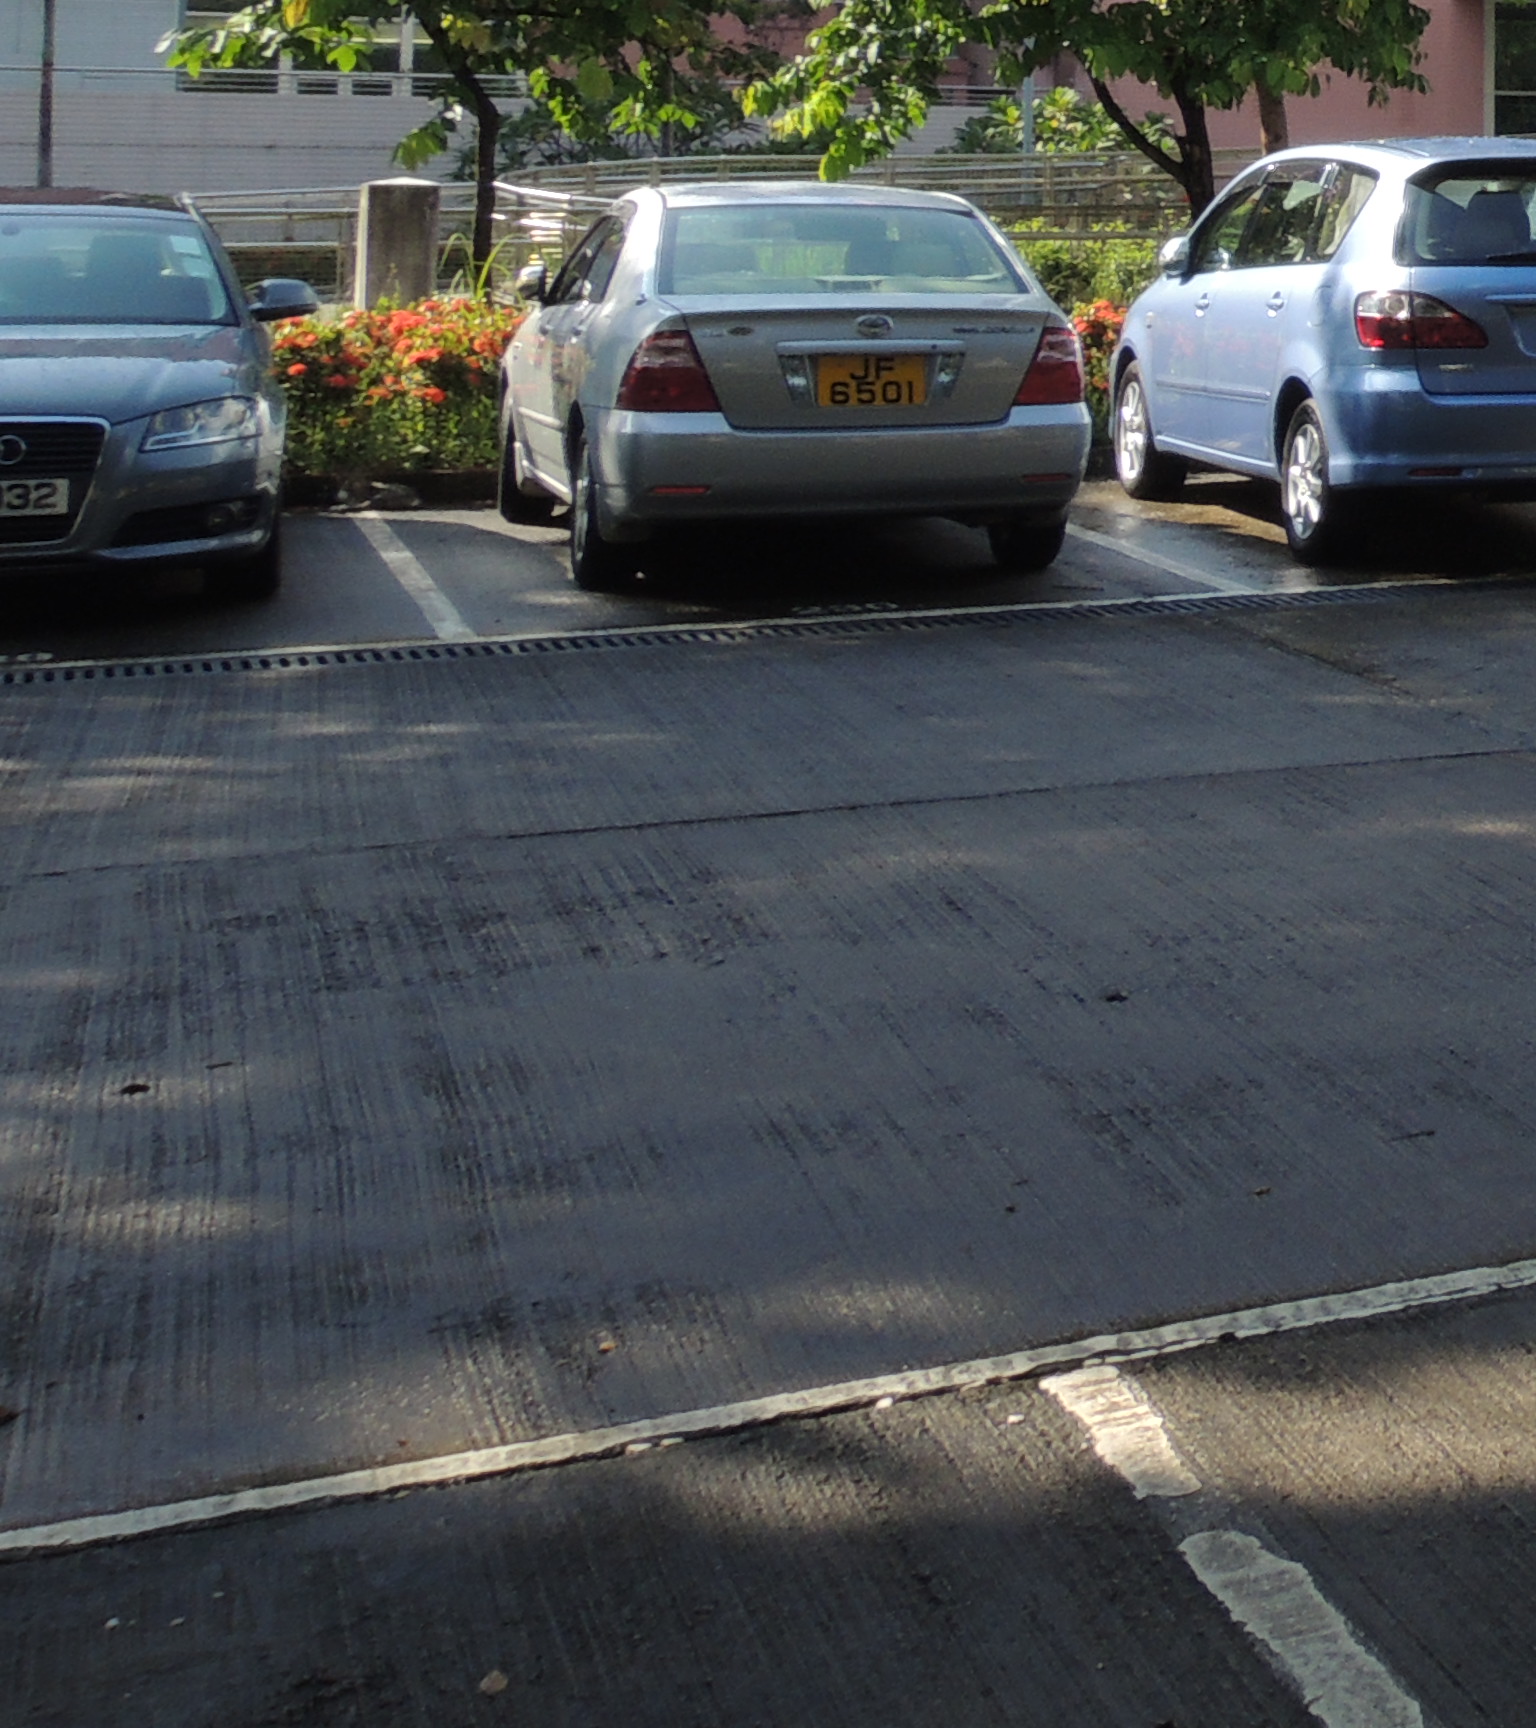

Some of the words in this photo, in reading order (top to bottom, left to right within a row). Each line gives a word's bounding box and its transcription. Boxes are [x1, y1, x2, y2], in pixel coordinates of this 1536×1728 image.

[850, 357, 895, 381] JF
[830, 381, 915, 405] 6501
[0, 482, 58, 510] 32
